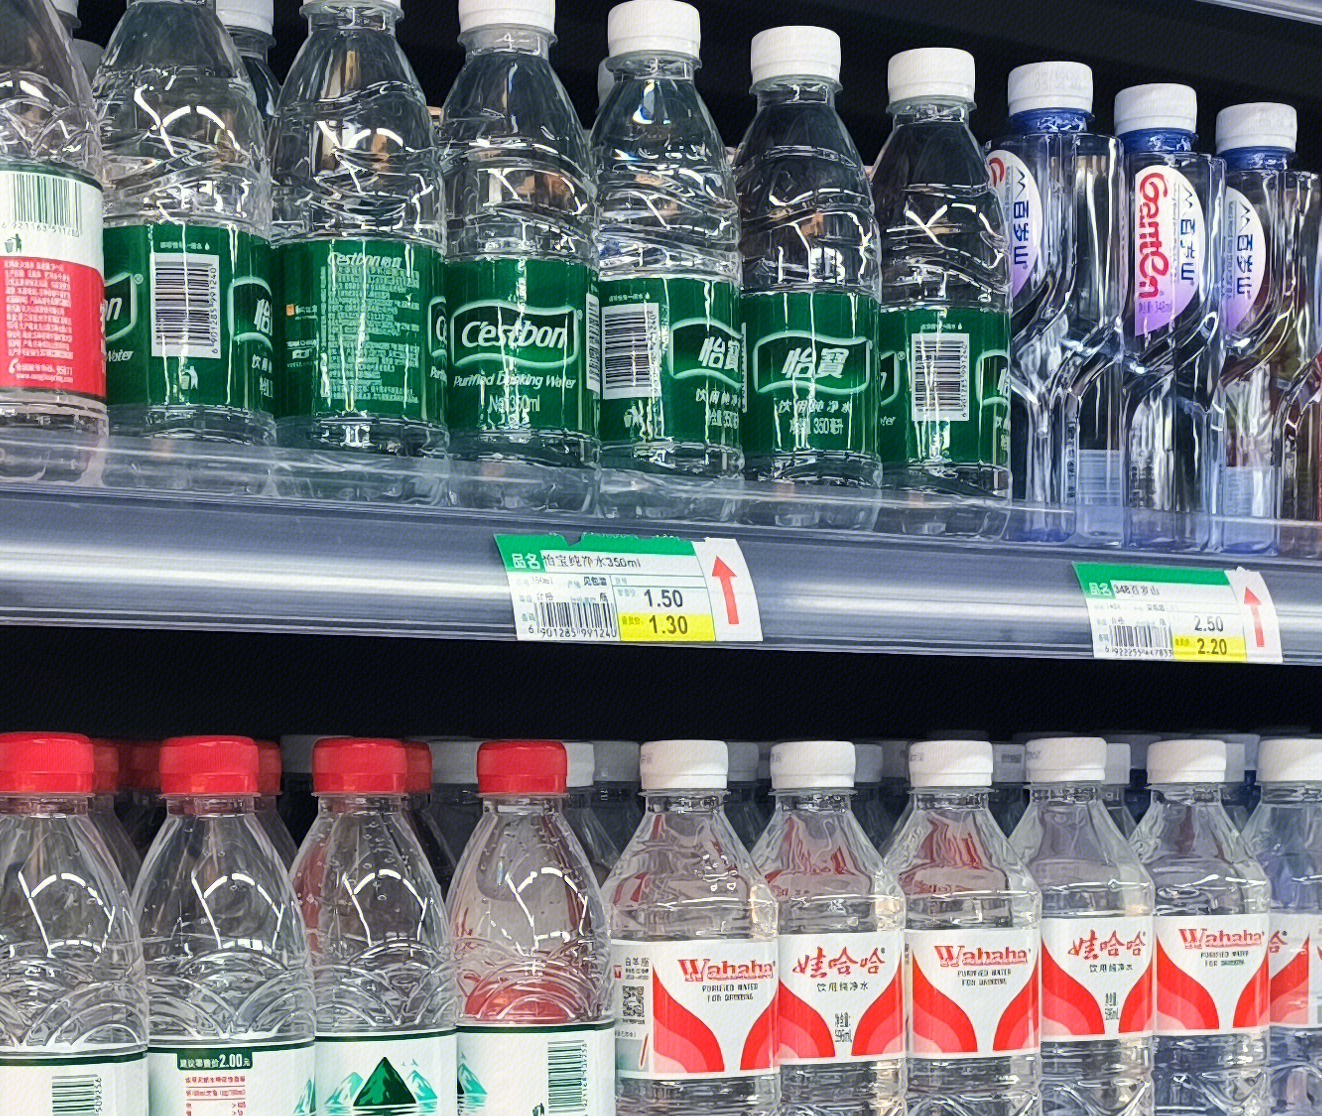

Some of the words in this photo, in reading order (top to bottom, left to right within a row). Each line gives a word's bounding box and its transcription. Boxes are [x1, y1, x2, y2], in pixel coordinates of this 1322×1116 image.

[782, 348, 850, 380] 怡寶
[511, 552, 540, 570] 品名
[644, 589, 683, 608] 1.50
[649, 615, 688, 634] 1.30
[1194, 616, 1224, 632] 2.50
[1197, 638, 1227, 655] 2.20
[1068, 929, 1146, 960] 娃哈哈
[1178, 928, 1263, 950] Wahaha
[792, 946, 885, 978] 娃哈哈
[934, 945, 1029, 967] Wahaha
[677, 958, 774, 983] Wahaha
